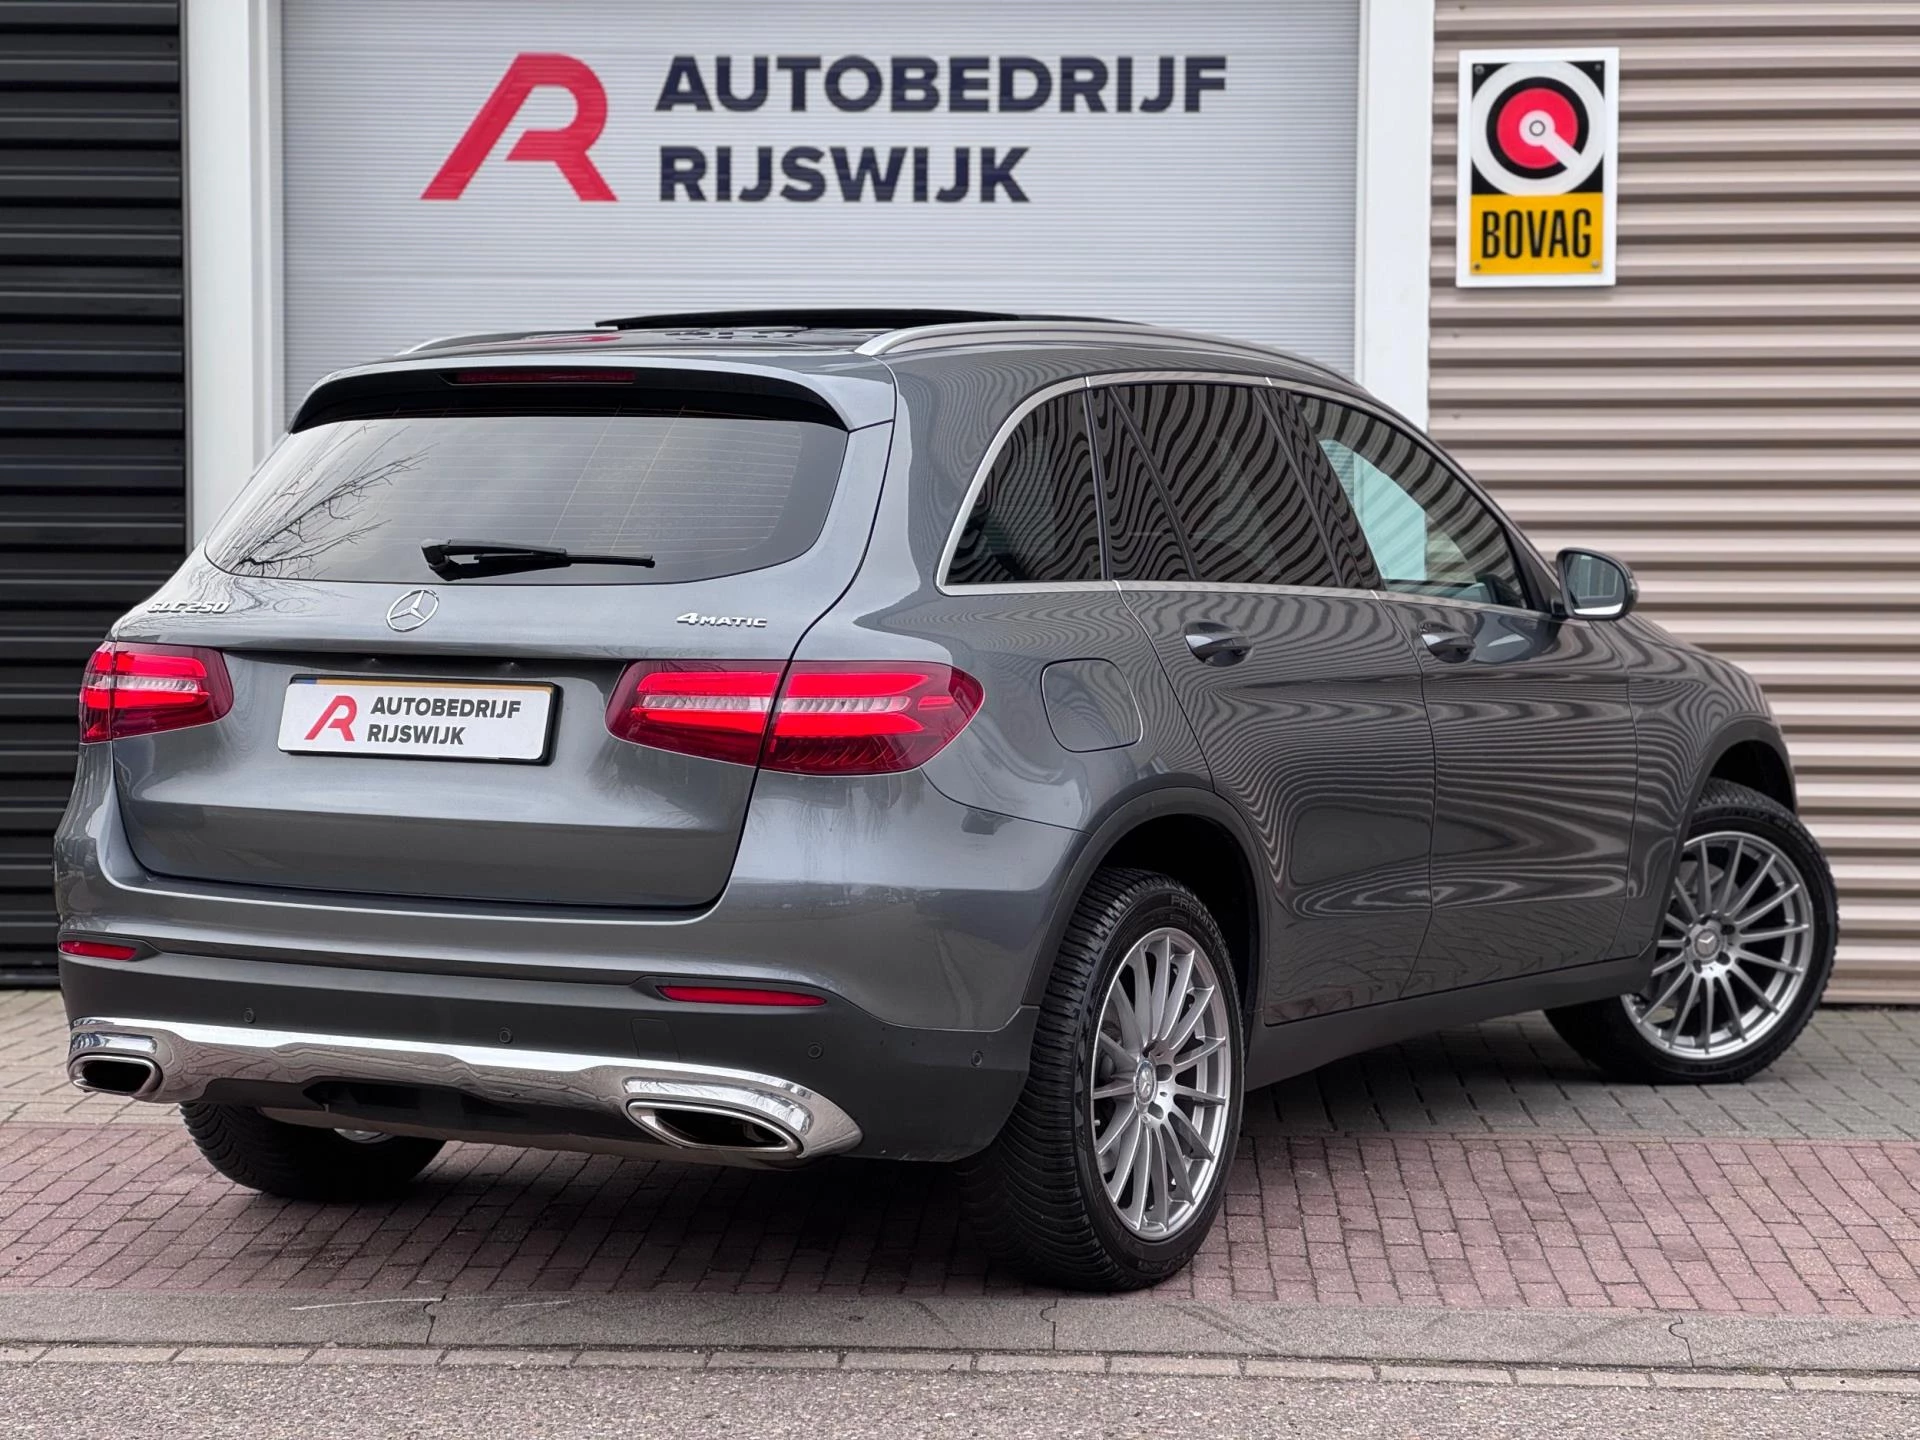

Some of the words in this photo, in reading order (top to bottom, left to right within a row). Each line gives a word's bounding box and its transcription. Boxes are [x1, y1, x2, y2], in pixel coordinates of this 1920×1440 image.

[656, 55, 1226, 113] AUTOBEDRIJF
[660, 146, 1029, 203] RIJSWIJK
[1482, 208, 1592, 260] BOVAG
[676, 612, 768, 628] 4MATIC
[370, 696, 521, 719] AUTOBEDRIJF
[367, 724, 466, 745] RIJSWIJK
